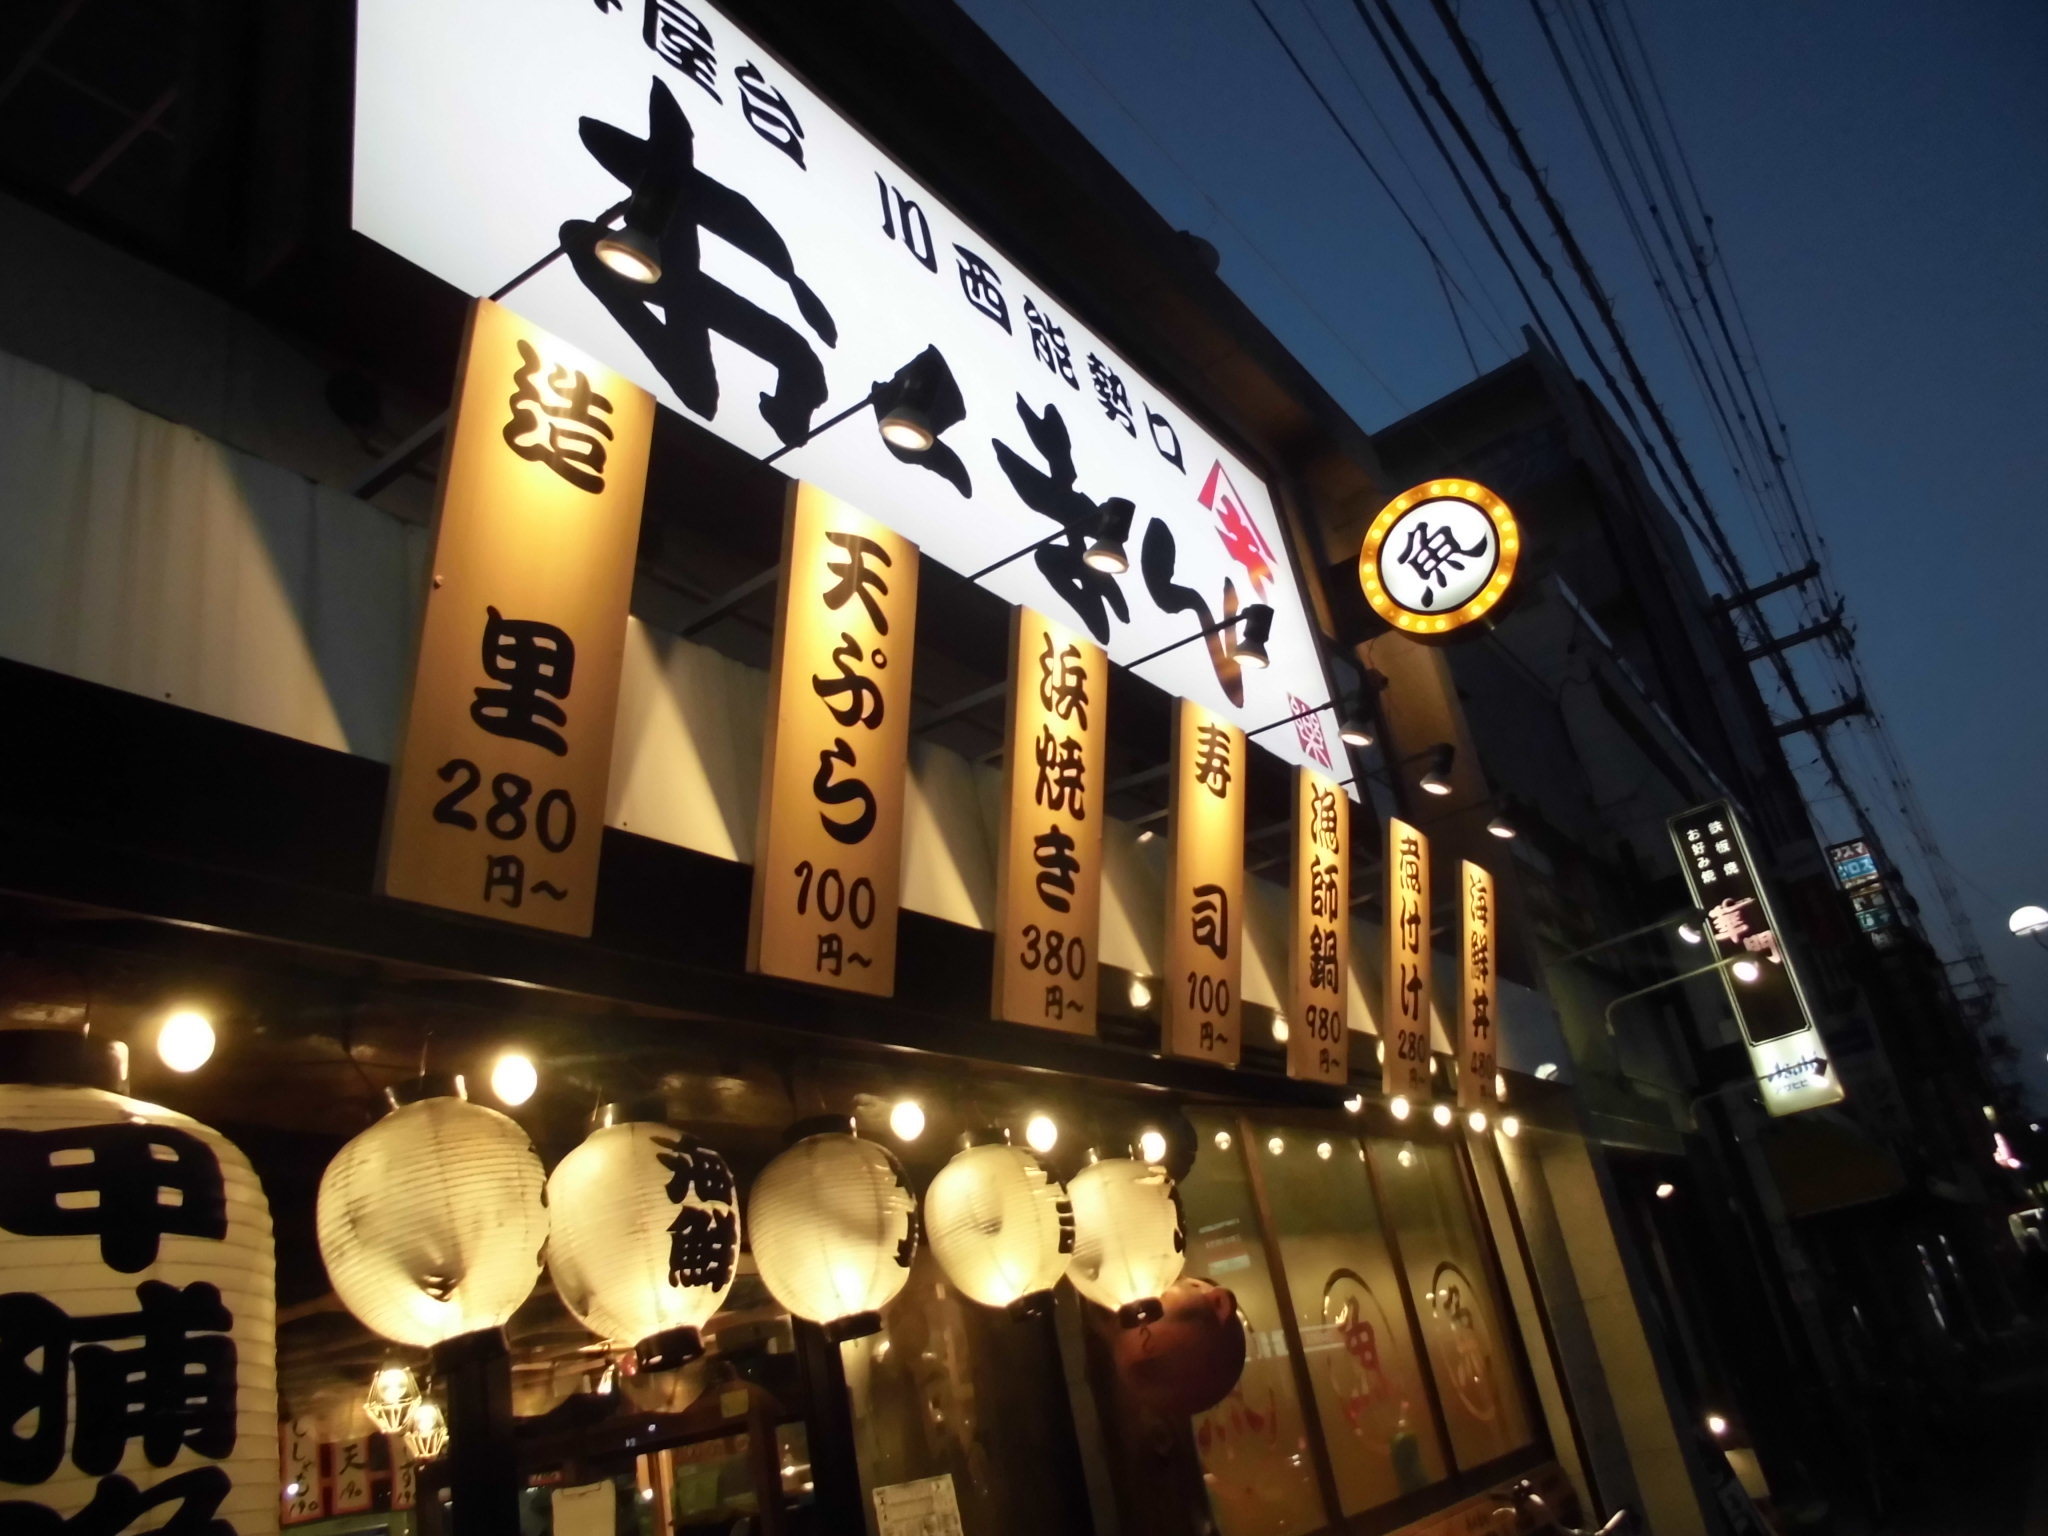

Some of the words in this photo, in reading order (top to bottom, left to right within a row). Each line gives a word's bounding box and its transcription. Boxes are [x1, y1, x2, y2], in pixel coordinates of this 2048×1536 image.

[594, 0, 808, 172] 屋台
[874, 171, 1187, 476] 川西能勢口
[470, 339, 614, 758] 造里
[1398, 521, 1488, 608] 魚
[811, 531, 893, 844] 天ぷら
[432, 759, 577, 854] 280
[1033, 631, 1089, 914] 浜焼き
[1191, 721, 1232, 960] 寿司
[794, 860, 876, 930] 100
[1020, 924, 1086, 980] 380
[1310, 781, 1340, 995] 漁師鍋
[1187, 971, 1230, 1016] 100
[1305, 1004, 1342, 1043] 980
